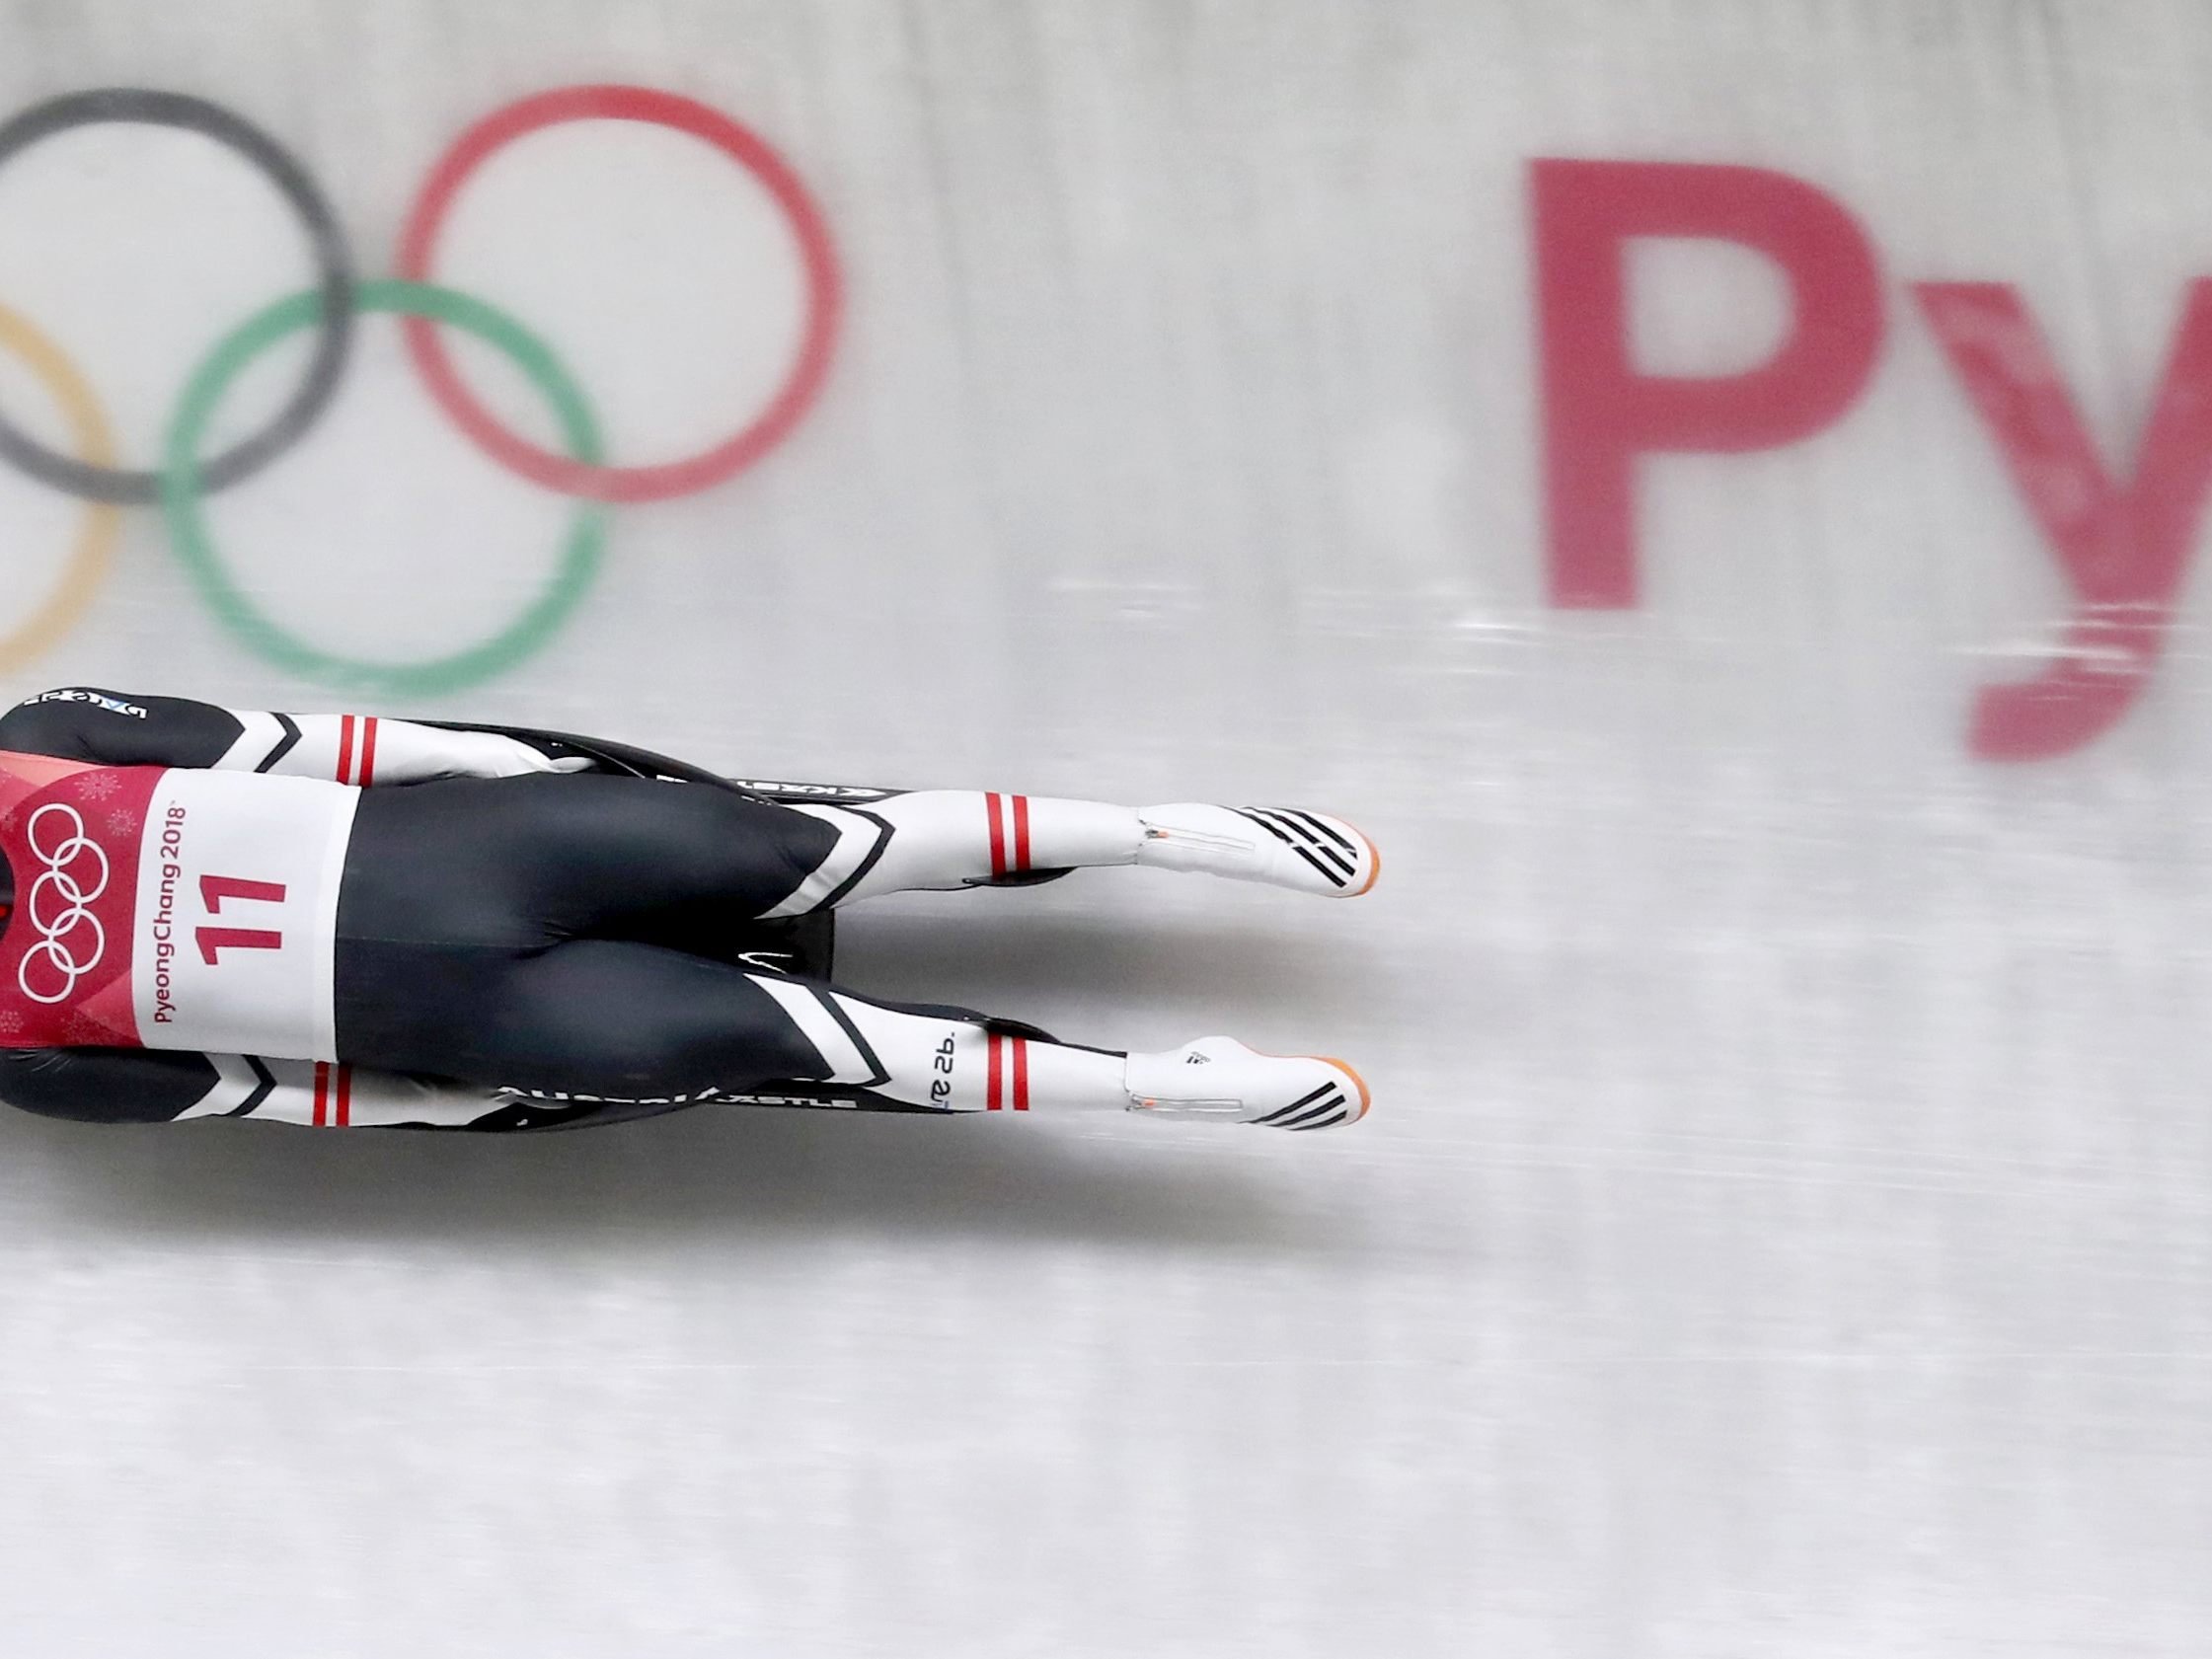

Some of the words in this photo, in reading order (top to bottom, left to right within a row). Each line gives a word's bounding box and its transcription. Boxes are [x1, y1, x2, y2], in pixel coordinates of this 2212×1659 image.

[1528, 156, 2212, 760] Py
[160, 808, 186, 859] 2018
[153, 863, 182, 1024] PyeongChang
[194, 874, 286, 966] 11
